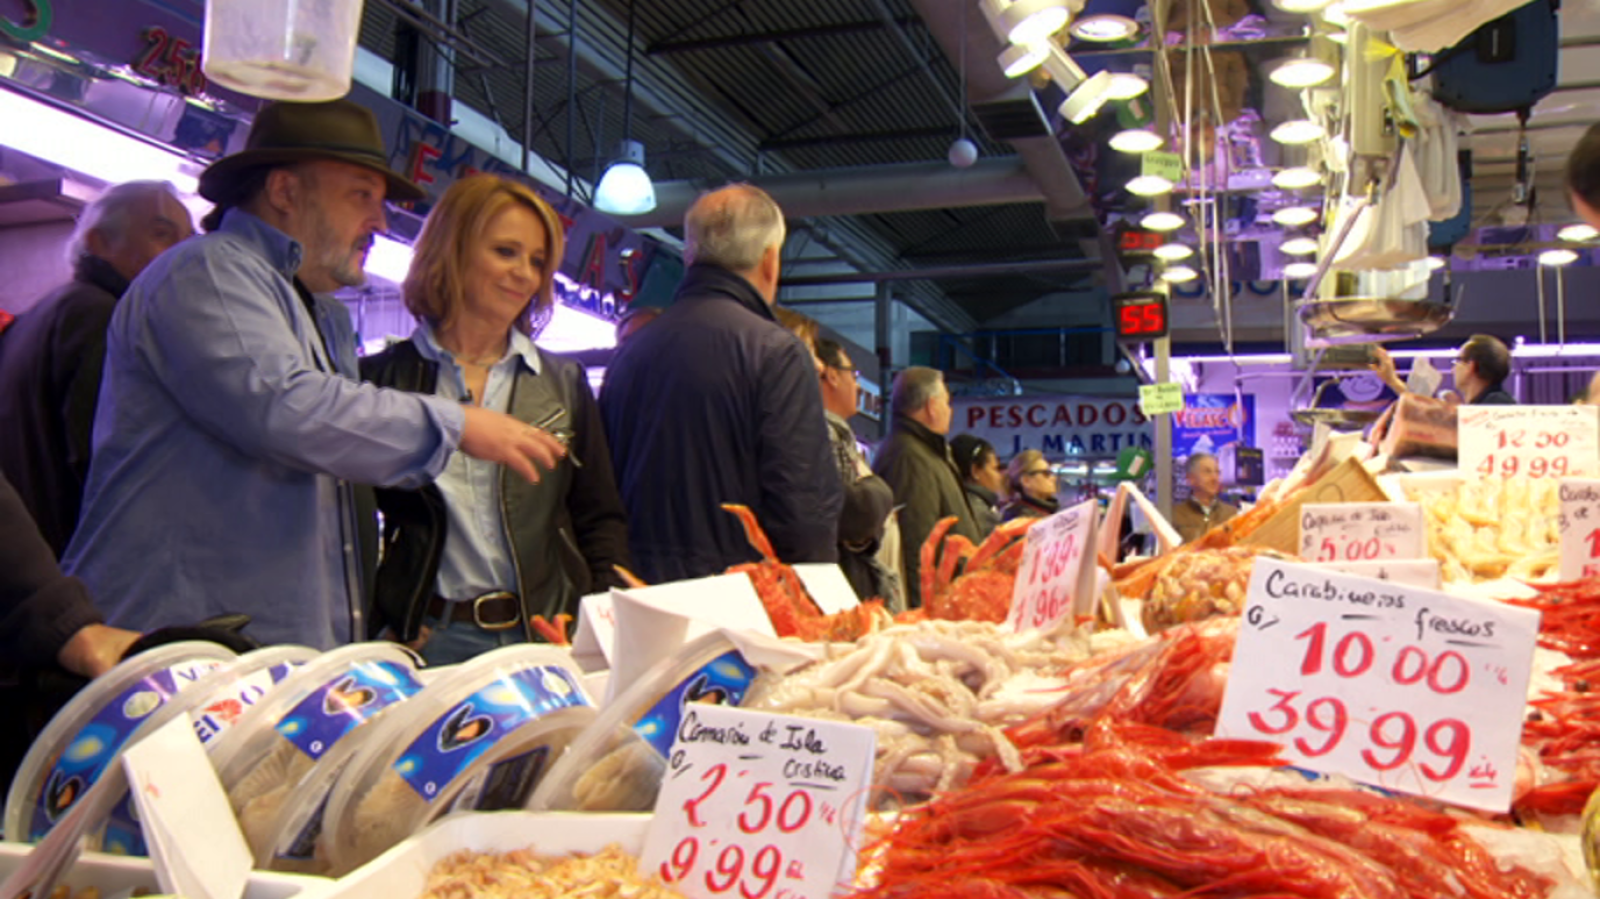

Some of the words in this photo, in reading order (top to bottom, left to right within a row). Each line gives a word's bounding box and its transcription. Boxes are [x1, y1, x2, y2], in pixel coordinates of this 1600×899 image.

[1120, 302, 1163, 335] 55
[966, 403, 1148, 428] PESCADOS
[1414, 605, 1497, 641] frescos
[758, 719, 777, 743] de
[779, 725, 827, 754] Isla
